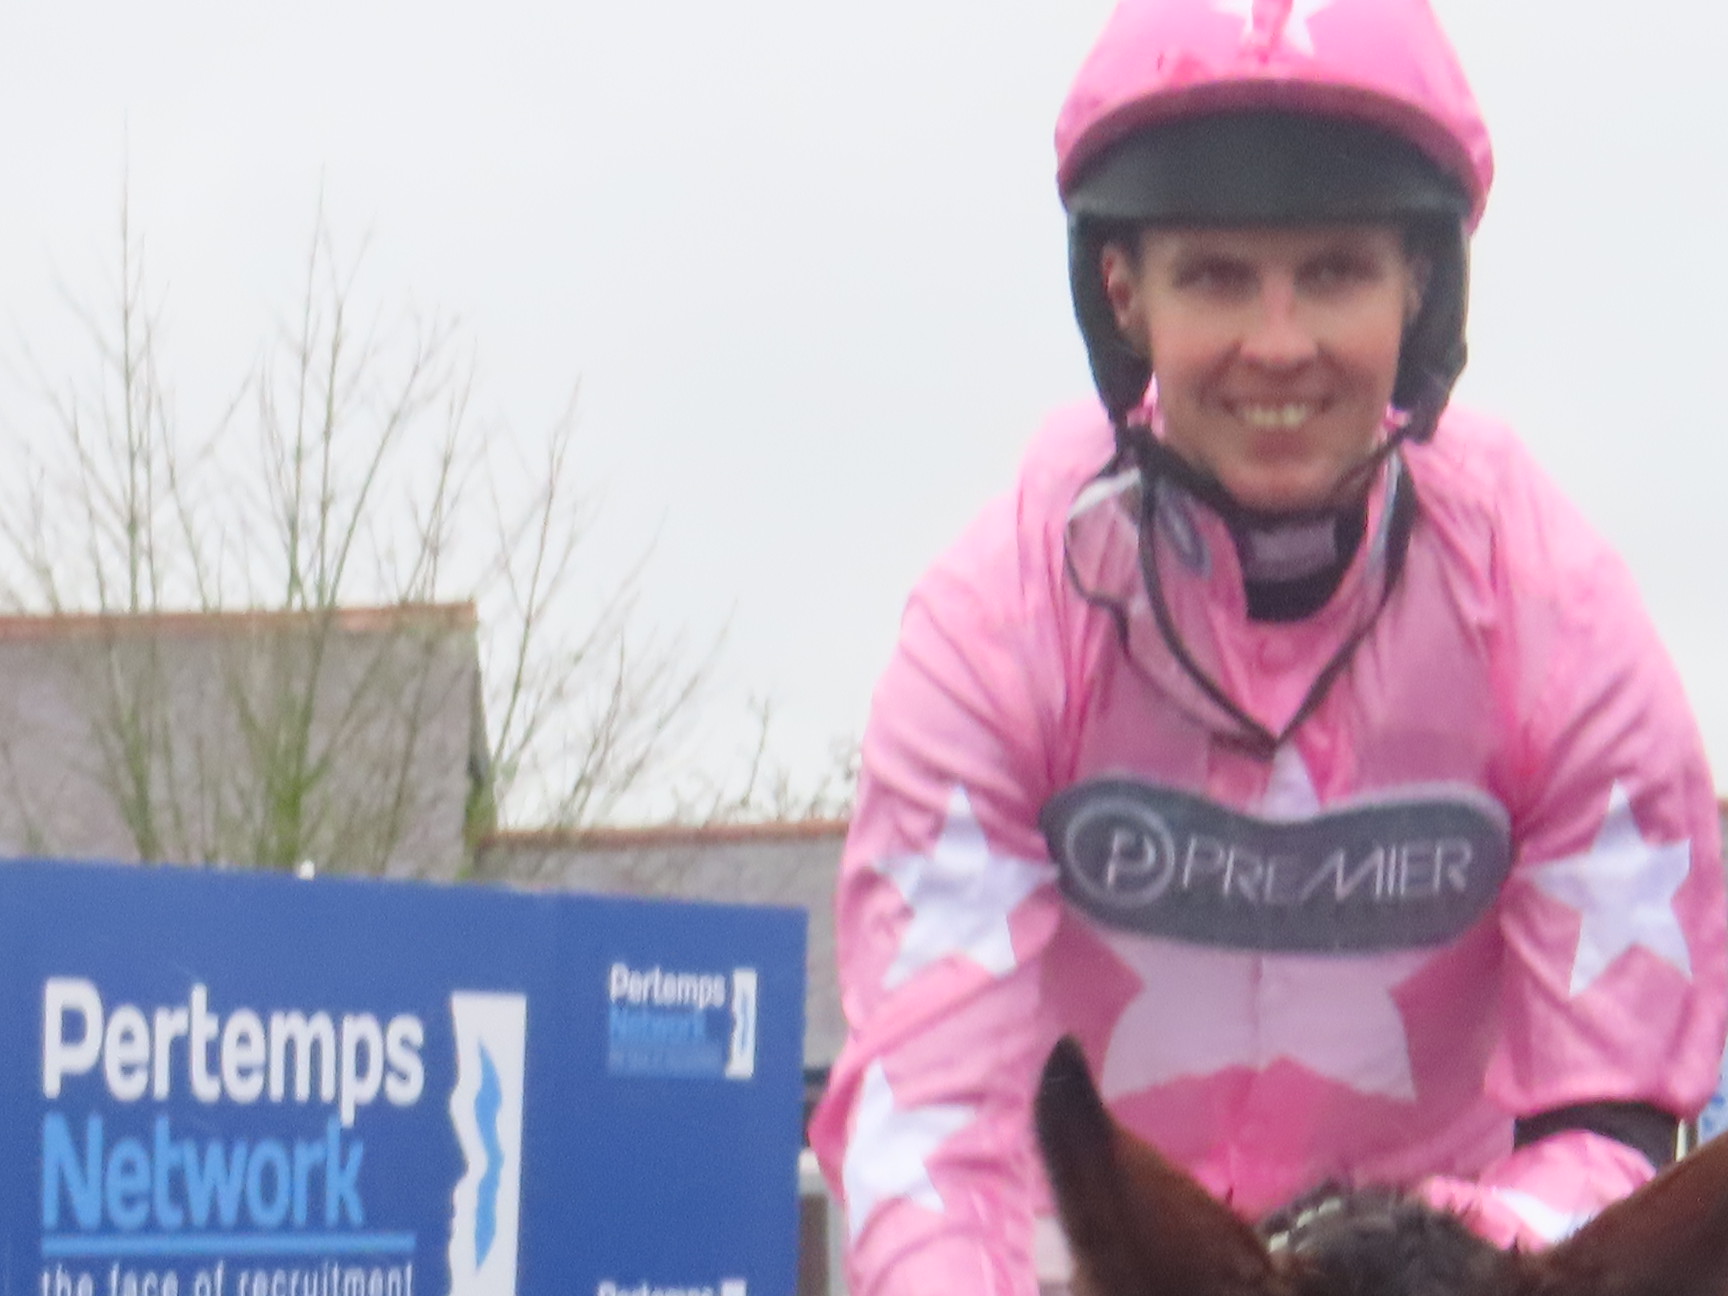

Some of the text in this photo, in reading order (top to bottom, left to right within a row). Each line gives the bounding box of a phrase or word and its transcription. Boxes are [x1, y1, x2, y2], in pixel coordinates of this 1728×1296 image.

[1183, 836, 1472, 902] PREMIER
[610, 963, 725, 1008] Pertemps
[42, 977, 426, 1128] Pertemps
[41, 1110, 366, 1229] Network
